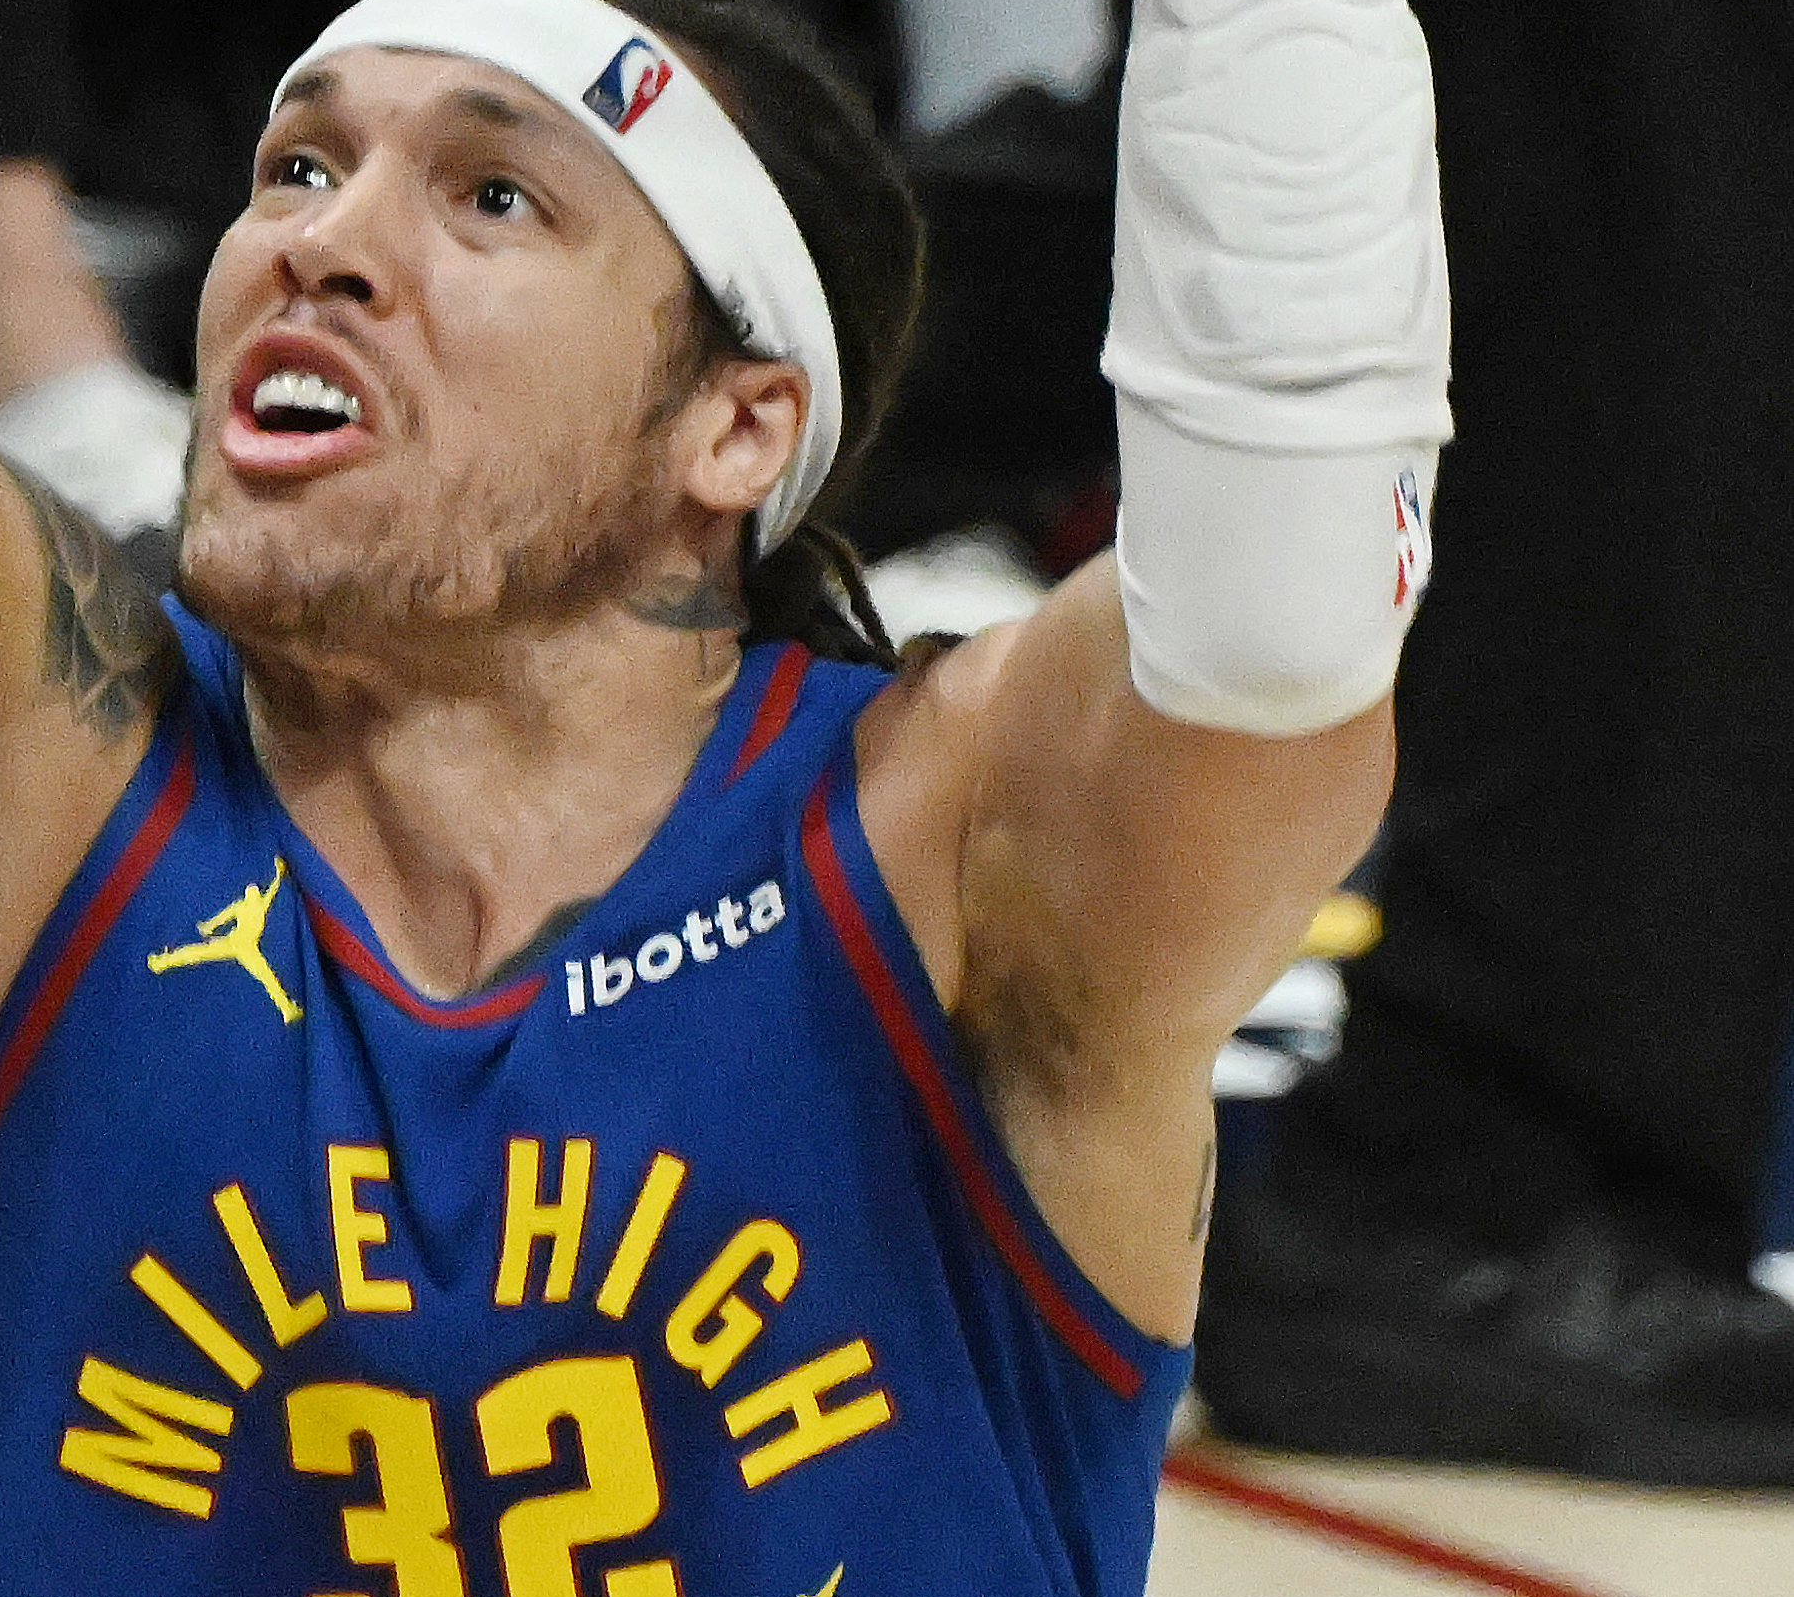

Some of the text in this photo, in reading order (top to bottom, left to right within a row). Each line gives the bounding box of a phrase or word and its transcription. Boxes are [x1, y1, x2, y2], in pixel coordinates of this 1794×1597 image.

[565, 880, 786, 1017] ibotta
[58, 1136, 896, 1522] MILE HIGH
